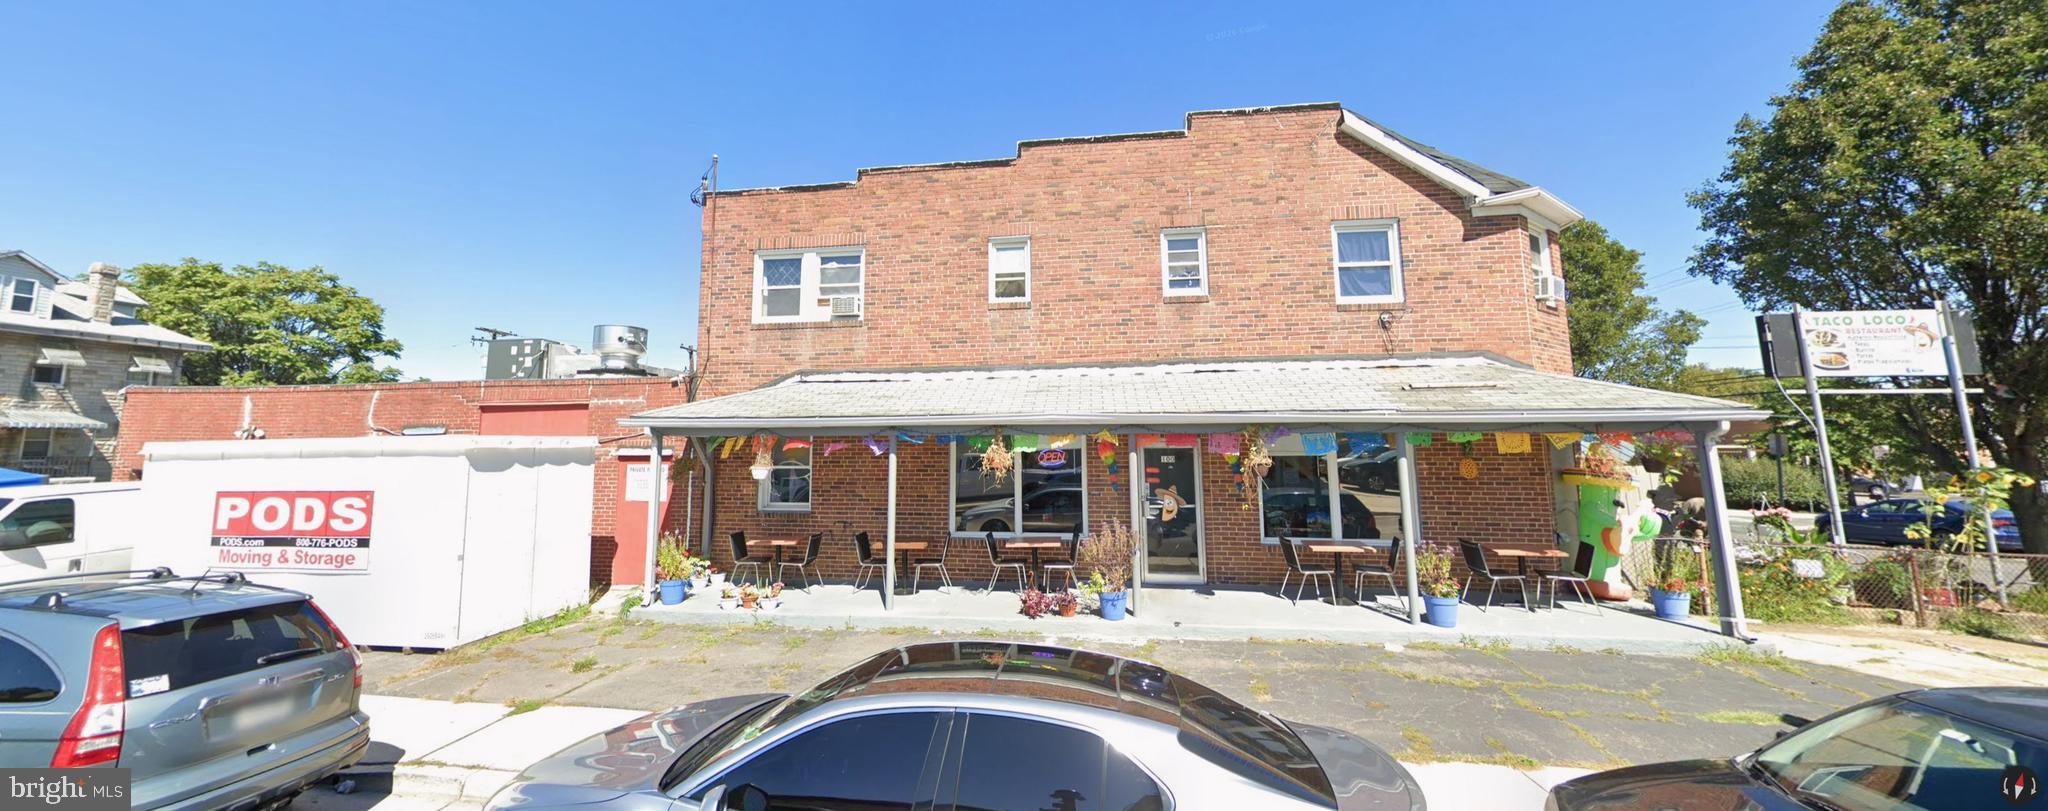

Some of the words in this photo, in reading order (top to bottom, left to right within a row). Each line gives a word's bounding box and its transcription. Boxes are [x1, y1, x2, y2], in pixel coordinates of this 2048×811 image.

[1811, 316, 1854, 326] TACO
[1863, 315, 1906, 325] LOCO
[1845, 327, 1902, 335] RESTAURANT
[1037, 451, 1066, 463] OPEN
[215, 496, 368, 532] PODS
[219, 538, 264, 547] PODS.com
[295, 538, 358, 548] 800-776-PODS
[218, 549, 272, 567] Moving
[277, 550, 290, 564] &
[294, 549, 356, 568] Storage
